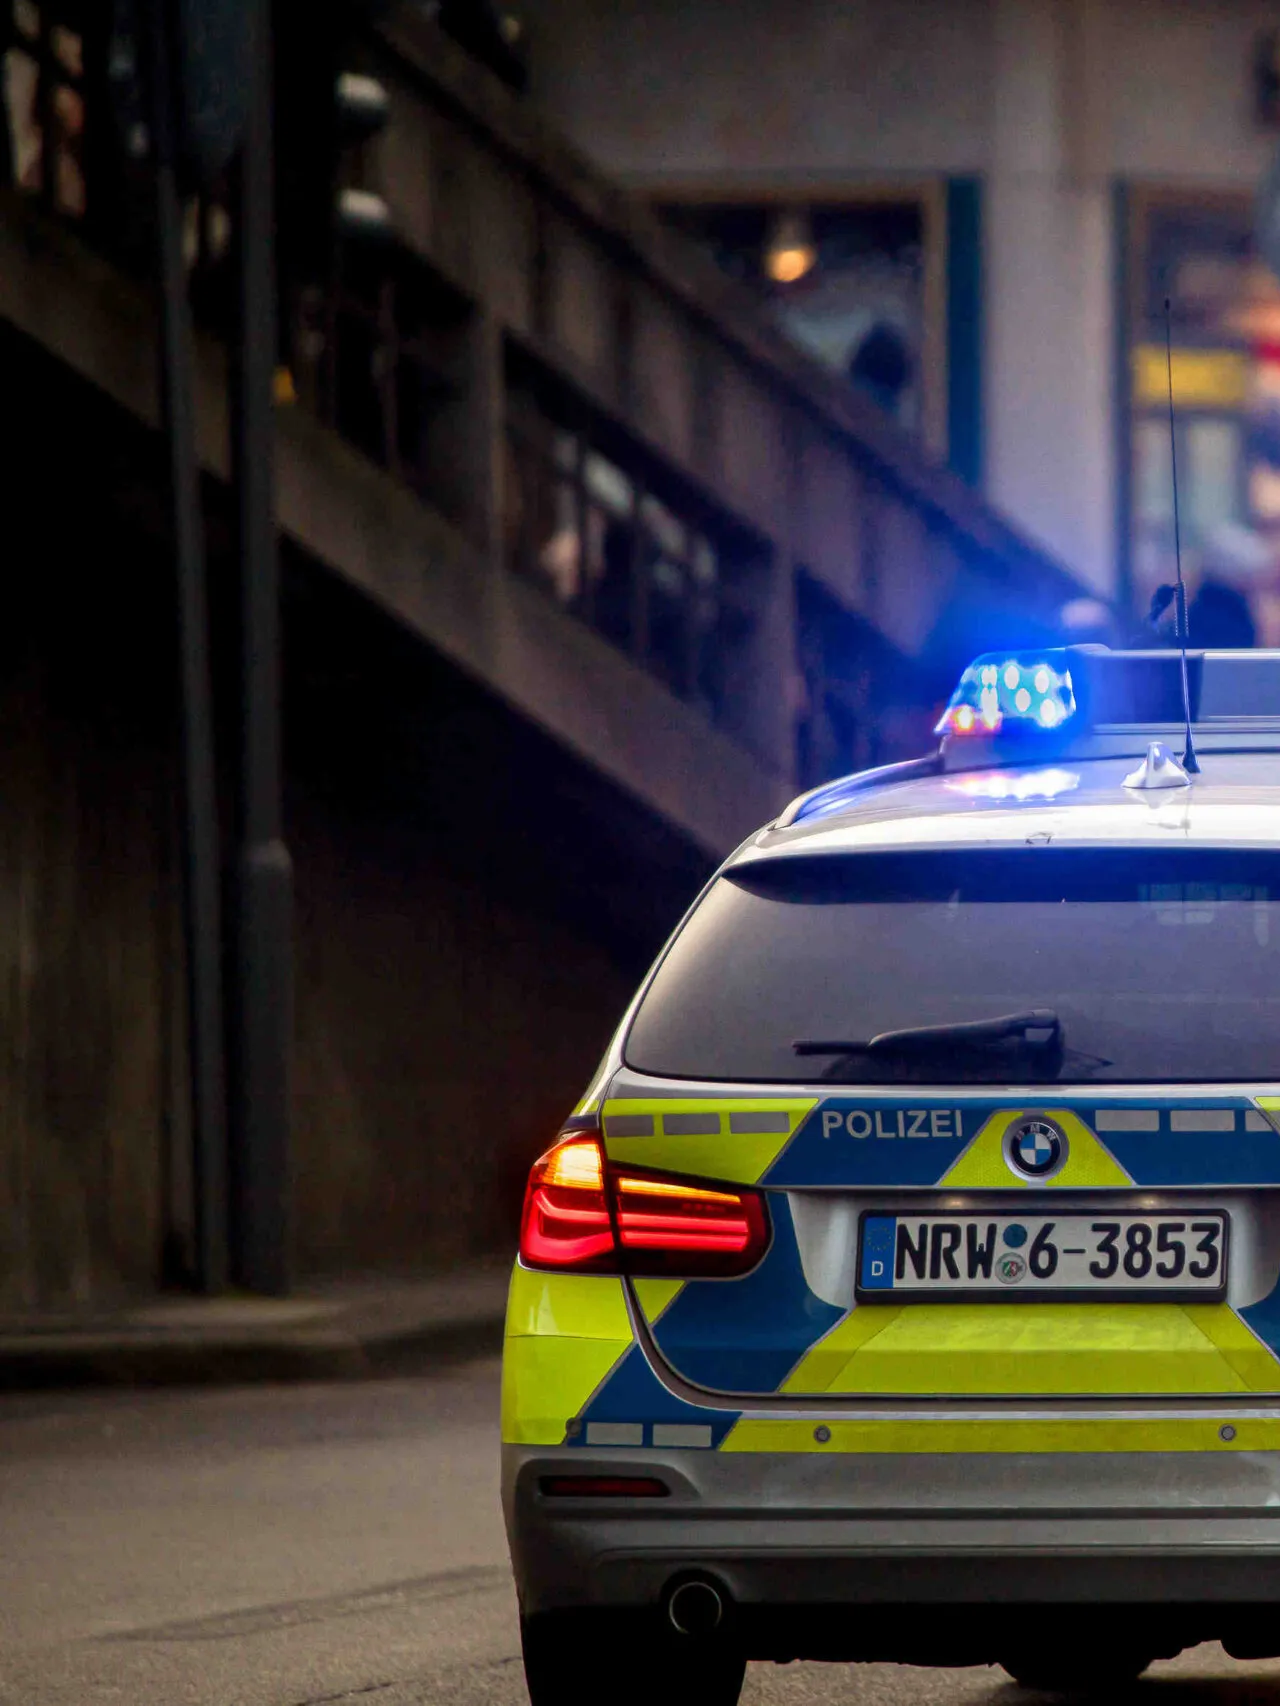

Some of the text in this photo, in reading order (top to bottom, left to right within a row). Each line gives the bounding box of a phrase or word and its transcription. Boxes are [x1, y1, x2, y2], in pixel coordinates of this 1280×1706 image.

[822, 1109, 963, 1139] POLIZEI
[1016, 1123, 1057, 1141] BMW
[895, 1222, 1221, 1280] NRW 6-3853
[871, 1261, 884, 1276] D
